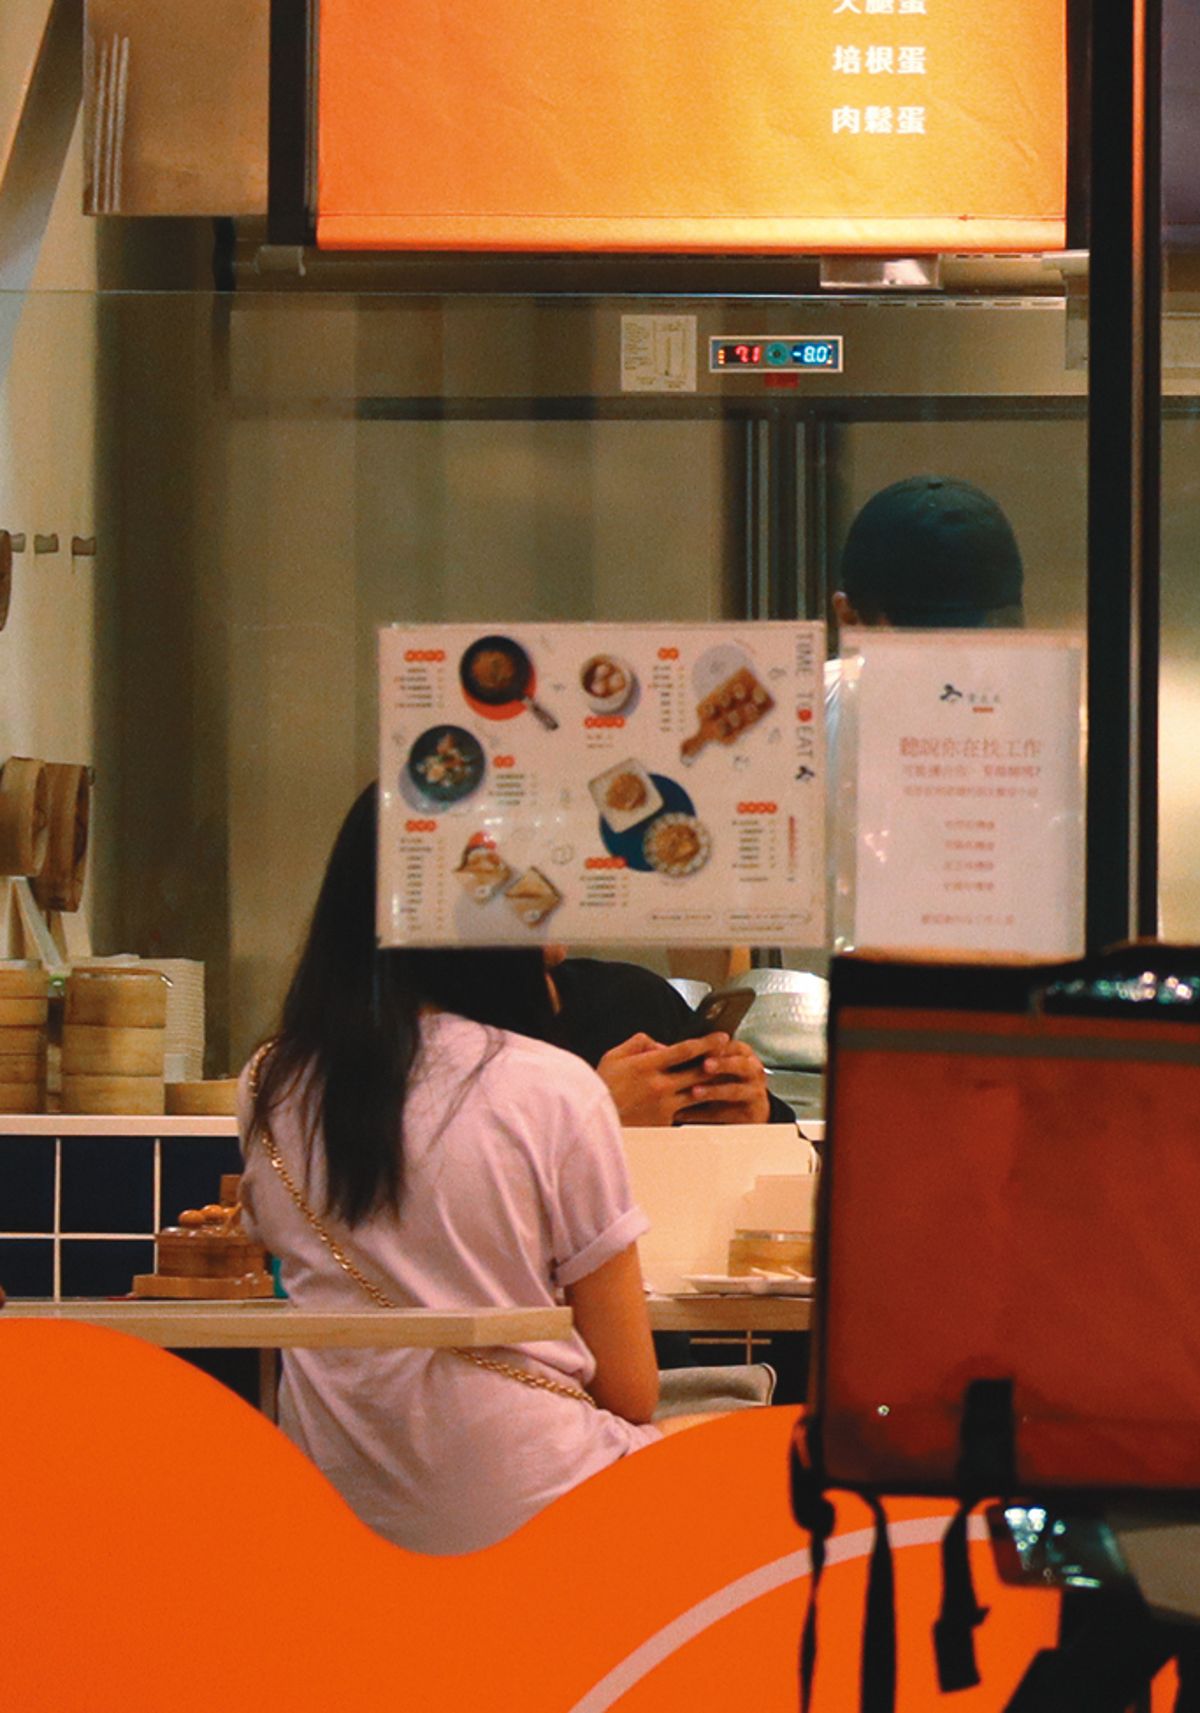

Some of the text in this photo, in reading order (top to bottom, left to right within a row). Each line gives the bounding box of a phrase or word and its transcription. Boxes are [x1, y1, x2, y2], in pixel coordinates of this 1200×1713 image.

[832, 45, 928, 76] 培根蛋
[831, 106, 928, 136] 肉鬆蛋
